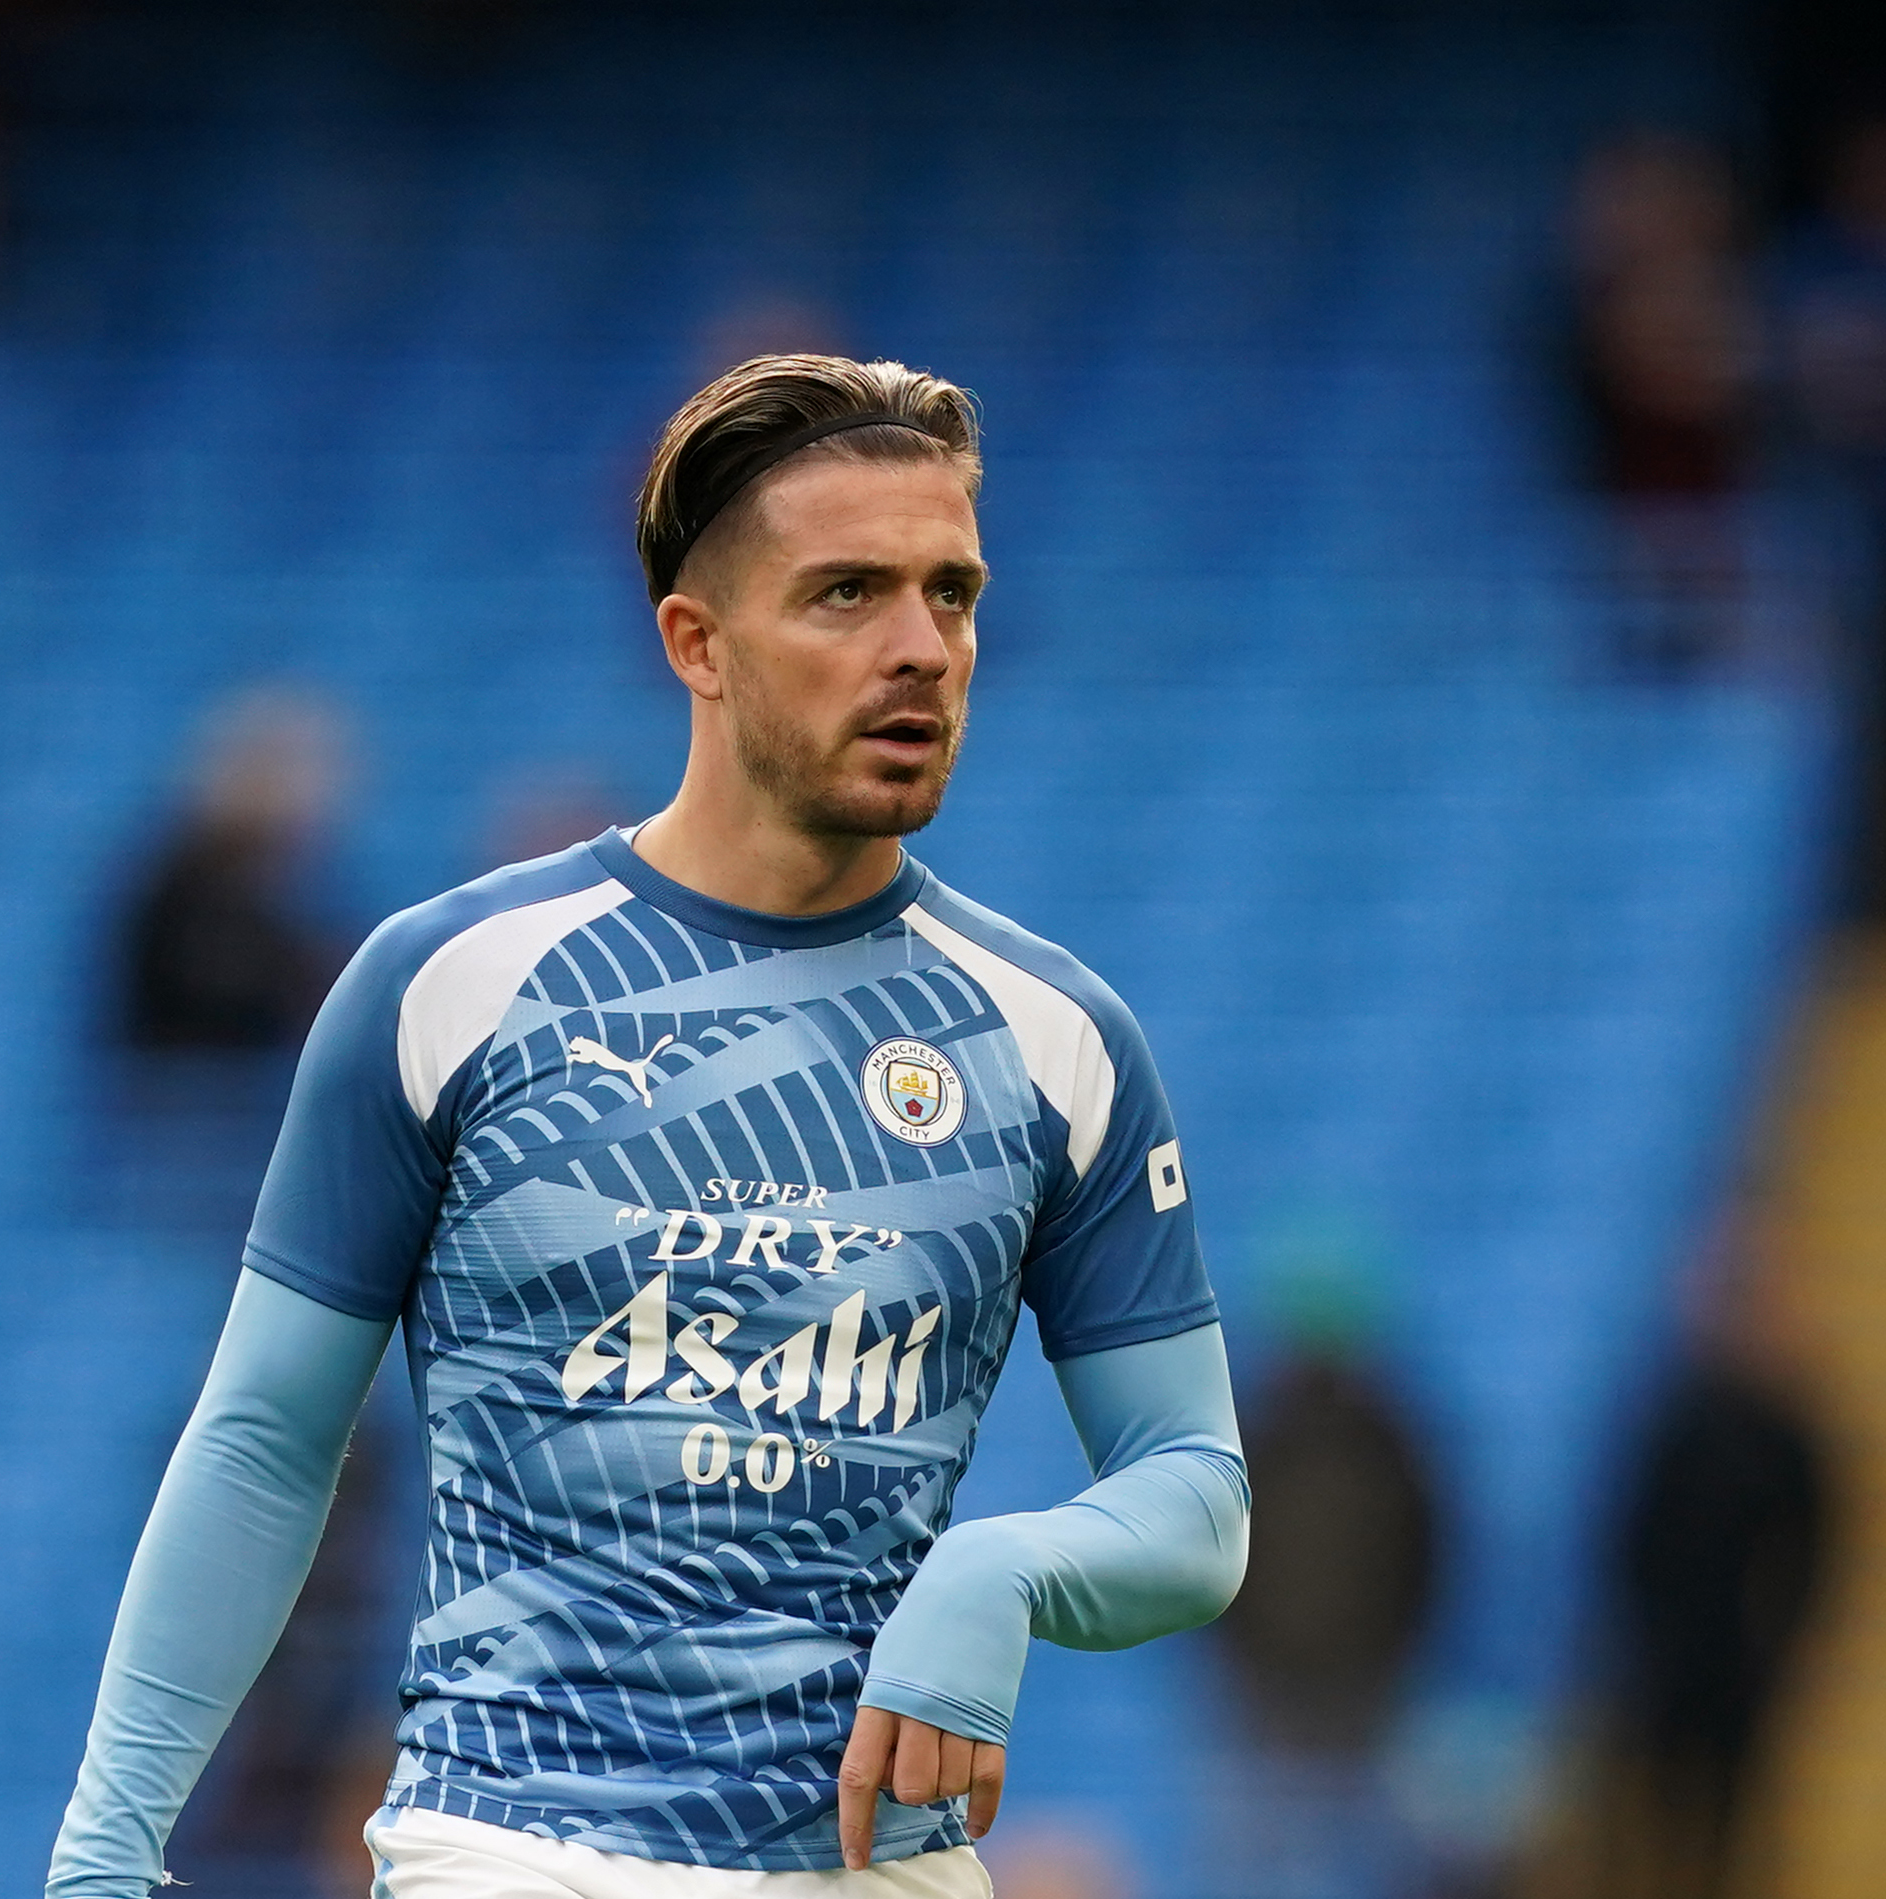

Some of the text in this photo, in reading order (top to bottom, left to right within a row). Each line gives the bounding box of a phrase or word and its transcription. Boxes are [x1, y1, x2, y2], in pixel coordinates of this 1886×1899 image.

[872, 1044, 956, 1085] MANCHESTER
[899, 1125, 930, 1140] CITY
[700, 1178, 829, 1209] SUPER
[561, 1270, 942, 1434] Asahi
[681, 1423, 834, 1493] 0.0%
